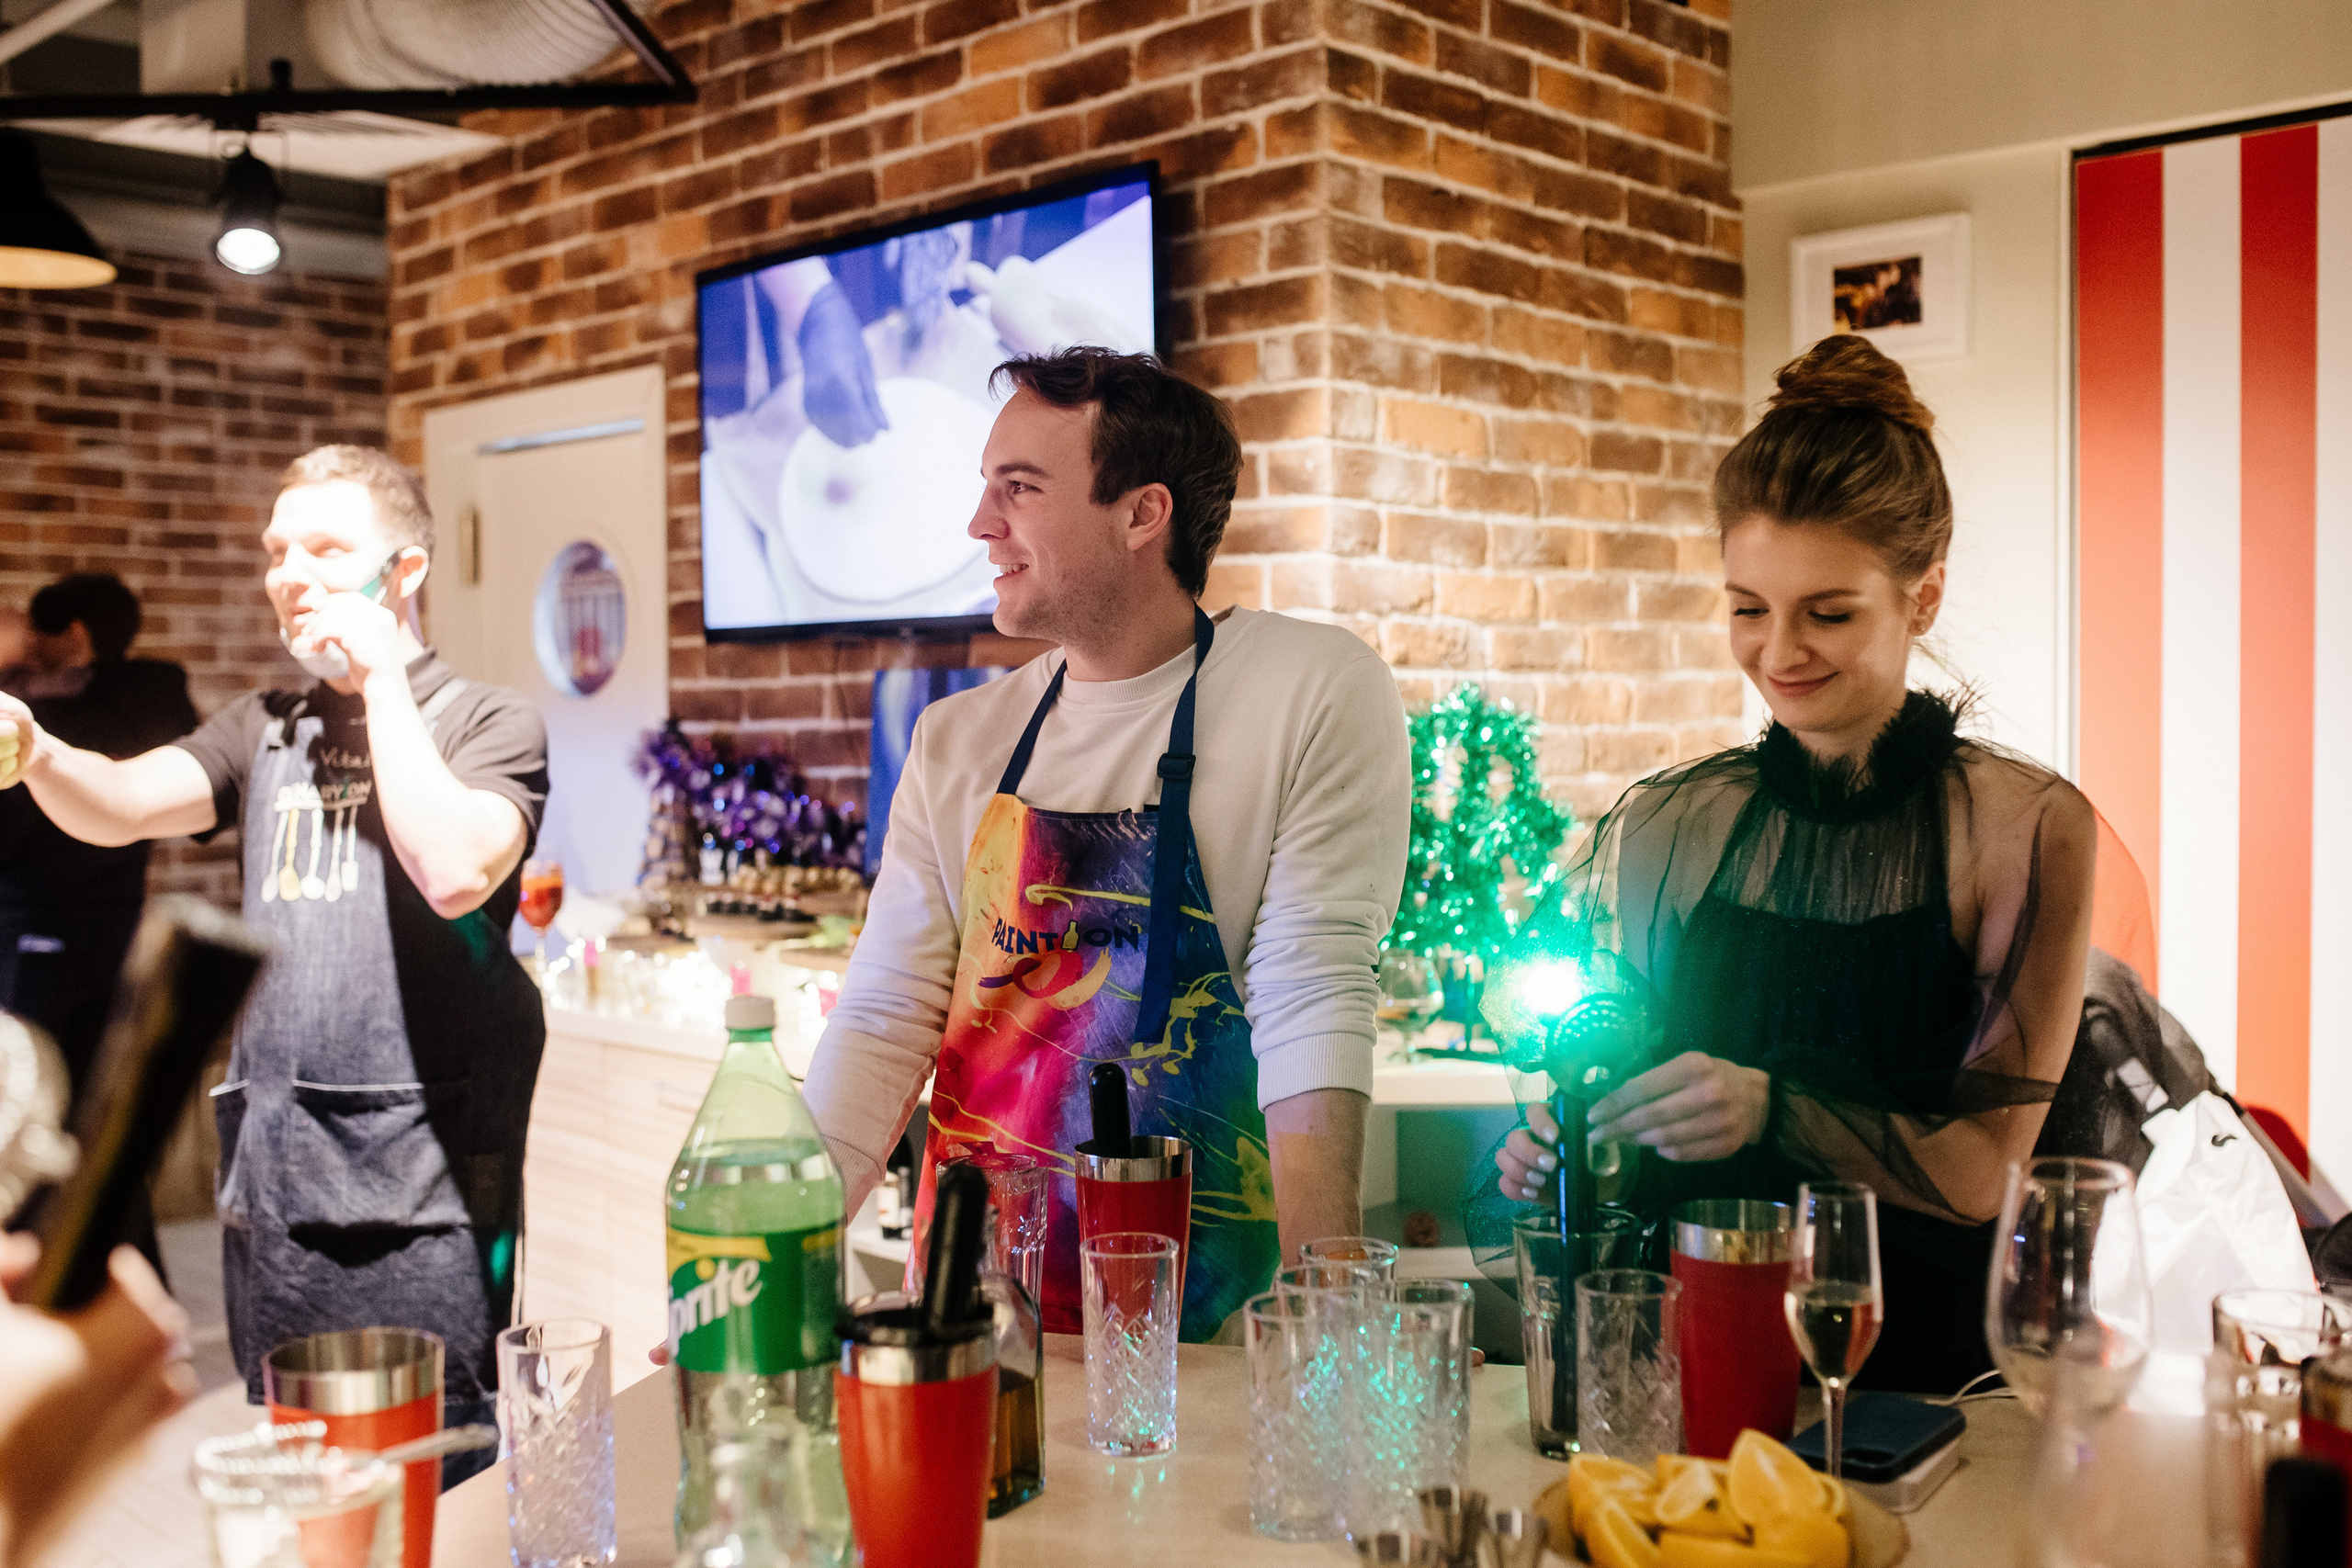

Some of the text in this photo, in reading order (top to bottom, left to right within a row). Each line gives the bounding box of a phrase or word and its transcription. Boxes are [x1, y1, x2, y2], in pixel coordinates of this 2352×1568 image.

[991, 917, 1139, 954] PAINT ON
[669, 1258, 763, 1360] prite
